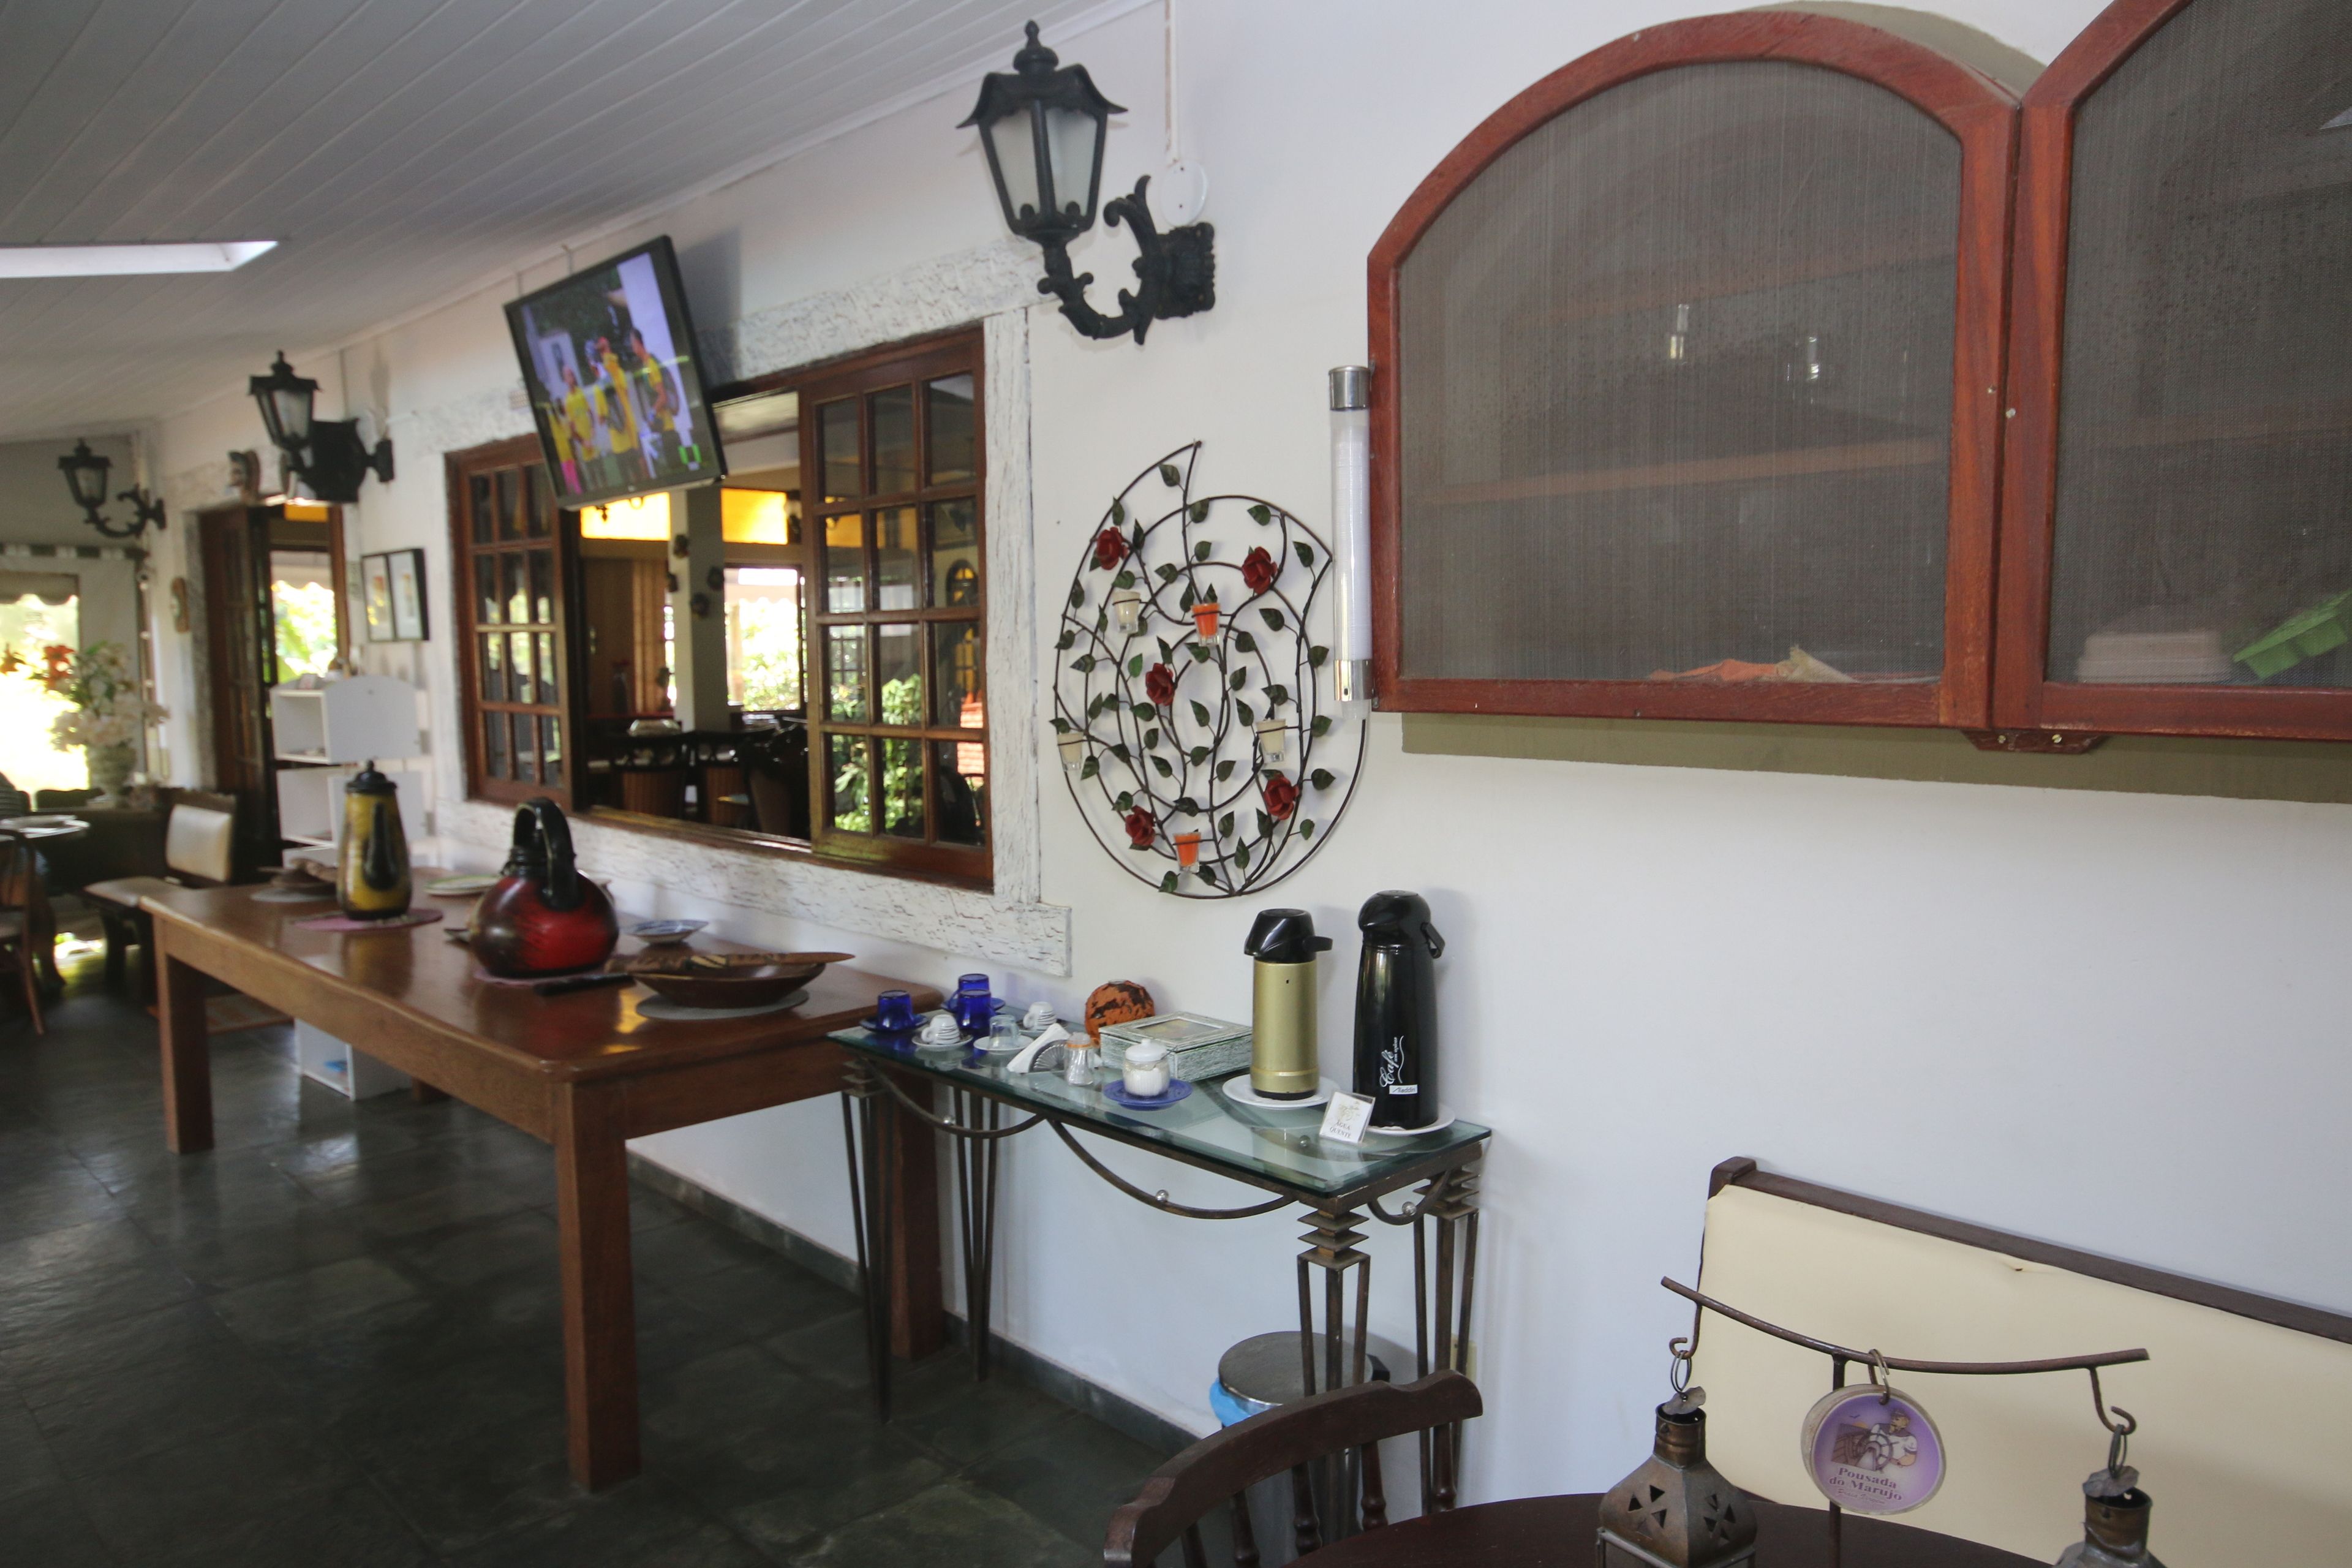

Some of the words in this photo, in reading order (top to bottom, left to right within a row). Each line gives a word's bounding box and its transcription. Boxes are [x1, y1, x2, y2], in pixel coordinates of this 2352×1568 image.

[1379, 1050, 1399, 1087] Café
[1330, 1126, 1351, 1138] QUENTE
[1829, 1476, 1845, 1487] do
[1850, 1479, 1902, 1501] Marujo
[1838, 1467, 1897, 1489] Pousada
